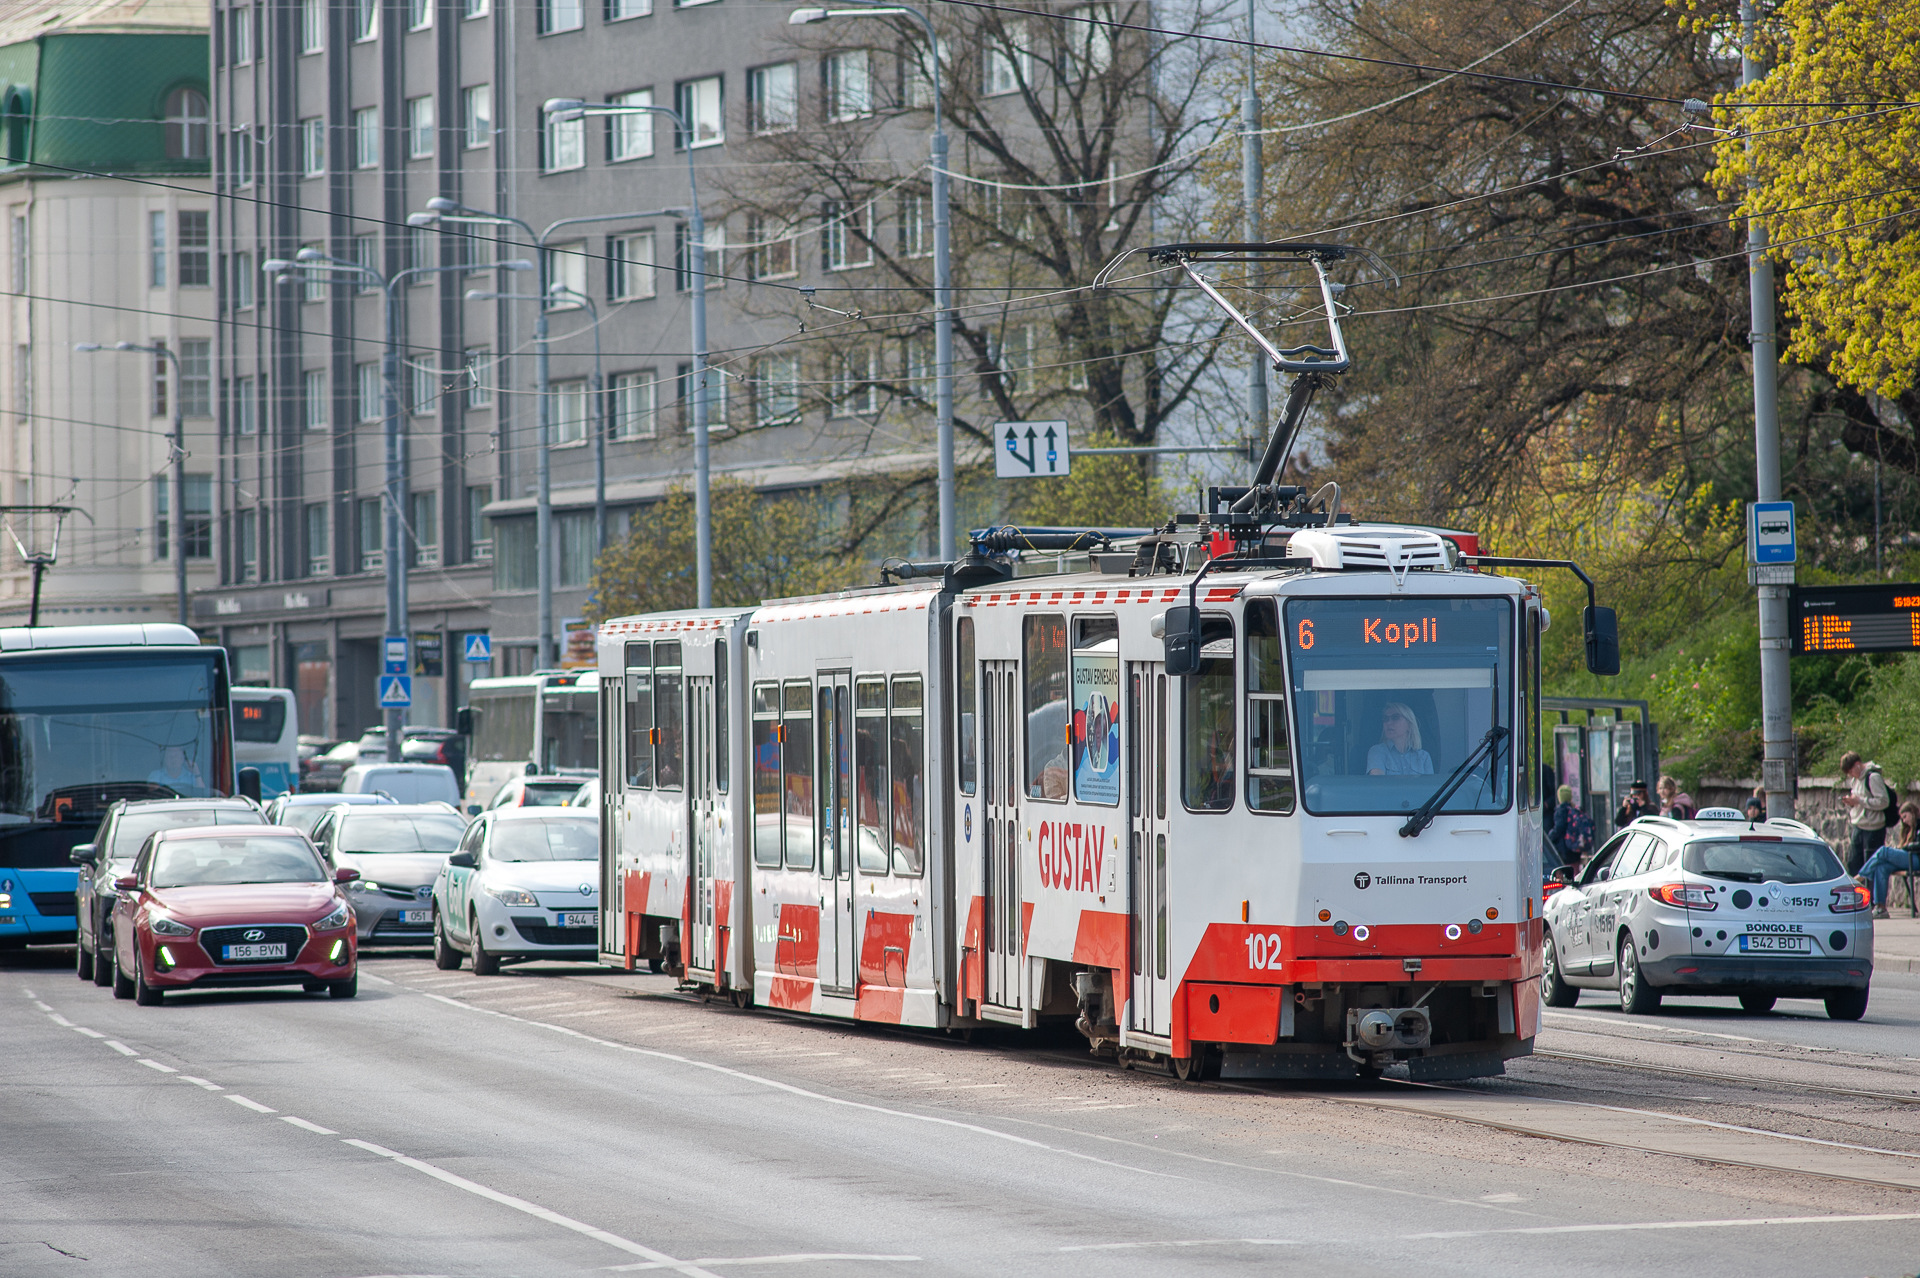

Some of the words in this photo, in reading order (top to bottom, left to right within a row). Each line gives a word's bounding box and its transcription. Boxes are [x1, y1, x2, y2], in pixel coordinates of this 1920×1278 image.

[1298, 619, 1315, 650] 6
[1364, 617, 1437, 649] Kopli
[1076, 667, 1093, 684] GUSTAV
[1094, 668, 1118, 685] ERNESAKS
[1038, 820, 1105, 894] GUSTAV
[1375, 875, 1415, 885] Tallinna
[1417, 875, 1468, 886] Transport
[1791, 897, 1820, 907] 15157
[411, 911, 426, 921] 051
[568, 914, 587, 925] 944
[1746, 923, 1803, 933] BONGO.EE
[1752, 937, 1774, 949] 542
[1779, 937, 1803, 949] BDT
[234, 946, 252, 957] 156
[259, 945, 284, 956] BVN
[1245, 933, 1283, 970] 102
